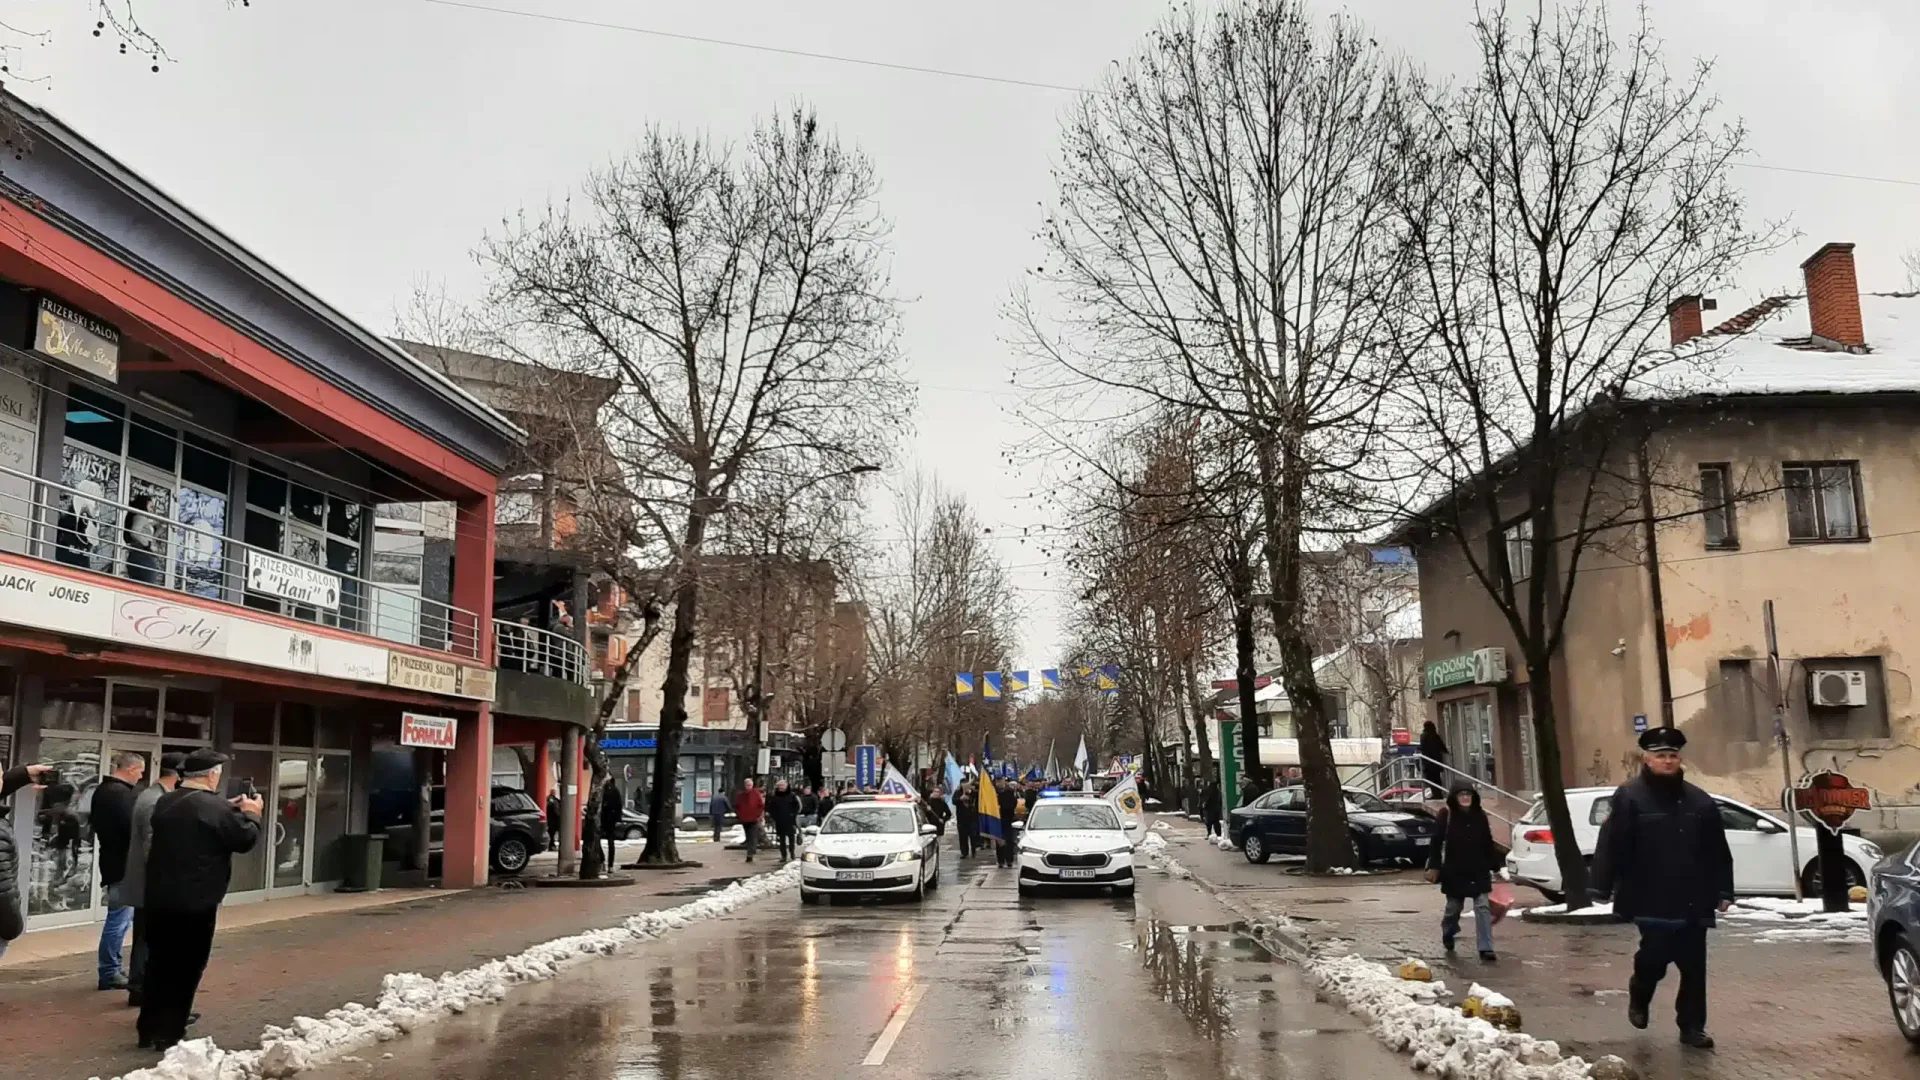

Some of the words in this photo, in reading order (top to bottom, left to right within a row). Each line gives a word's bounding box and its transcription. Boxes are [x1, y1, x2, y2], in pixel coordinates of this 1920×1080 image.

[42, 298, 87, 328] FRIZERSKI
[89, 321, 119, 343] SALON
[0, 394, 23, 416] ŠKI
[69, 453, 111, 482] MUŠKI
[253, 555, 304, 580] FRIZERSKI
[307, 571, 336, 589] SALON
[0, 574, 36, 593] JACK
[49, 585, 91, 604] JONES
[400, 656, 433, 673] FRIZERSKI
[435, 664, 455, 677] SALON
[403, 715, 454, 746] FORMULA
[598, 738, 658, 748] SPARKASSE
